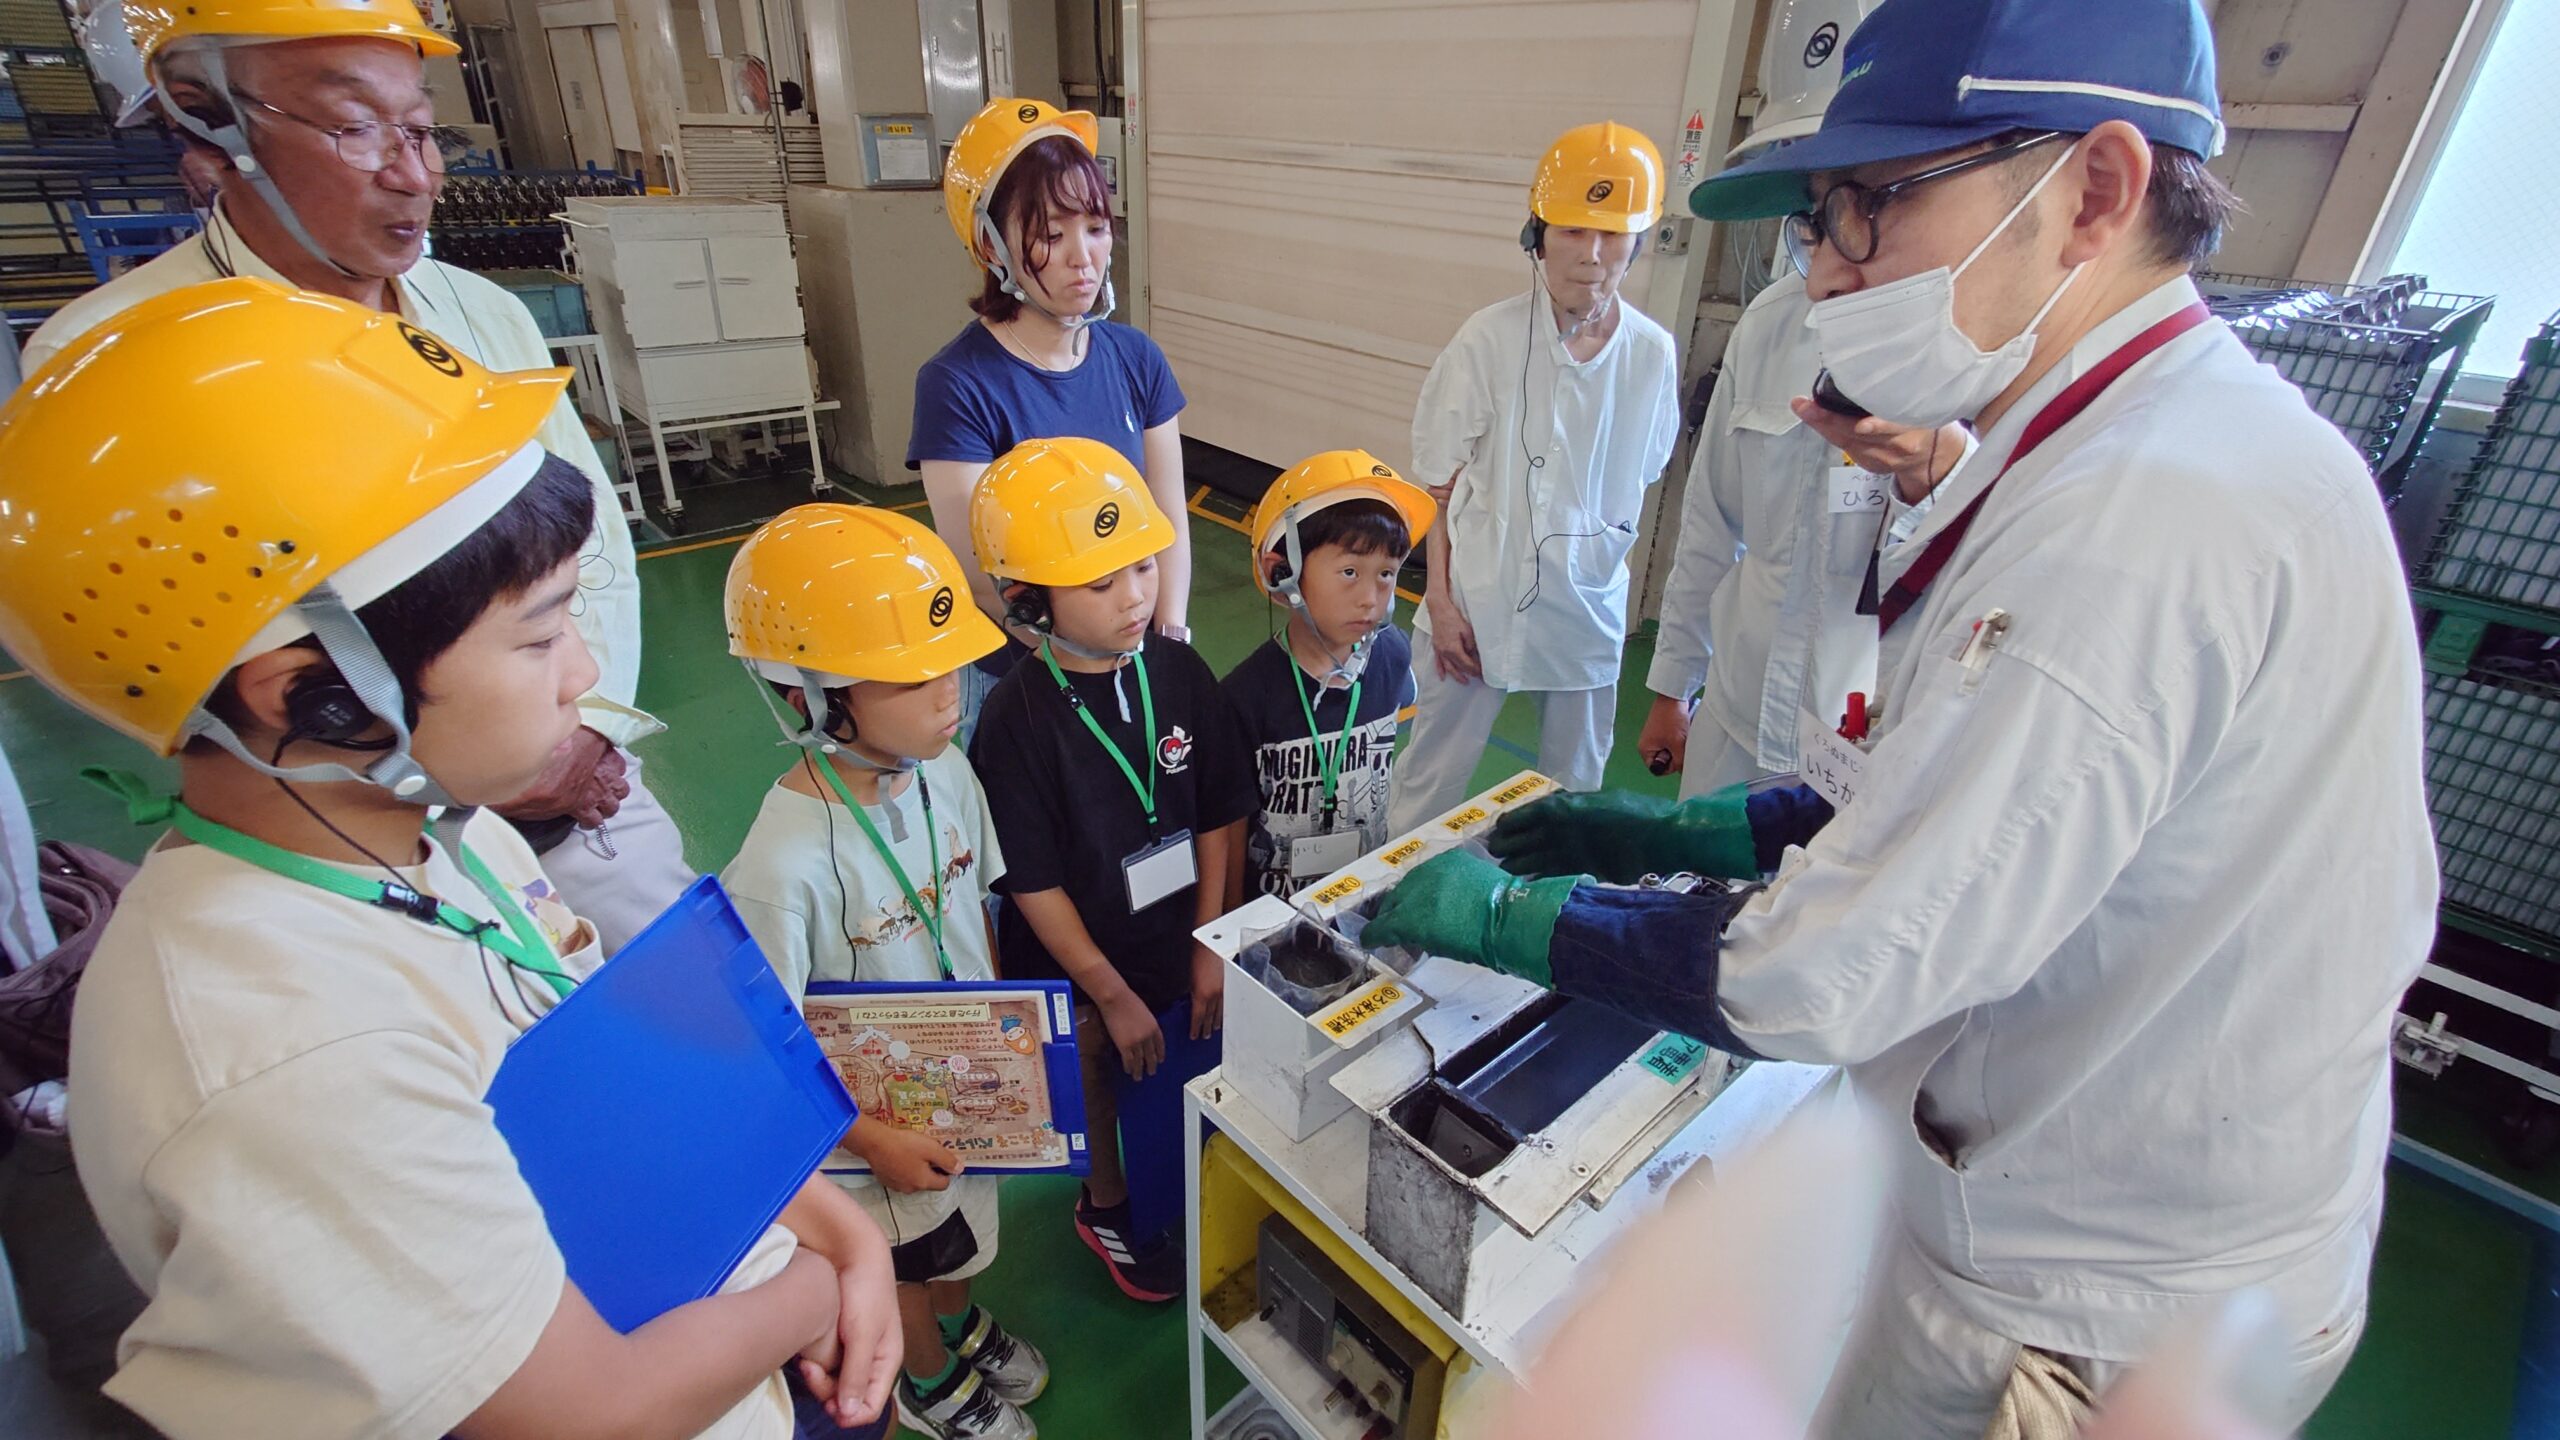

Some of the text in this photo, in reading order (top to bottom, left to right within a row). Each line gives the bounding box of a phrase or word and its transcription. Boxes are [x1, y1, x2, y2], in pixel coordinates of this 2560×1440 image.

[1842, 489, 1885, 507] ひろ
[1814, 733, 1863, 773] くろぬまじ
[937, 1136, 994, 1150] ベルラン
